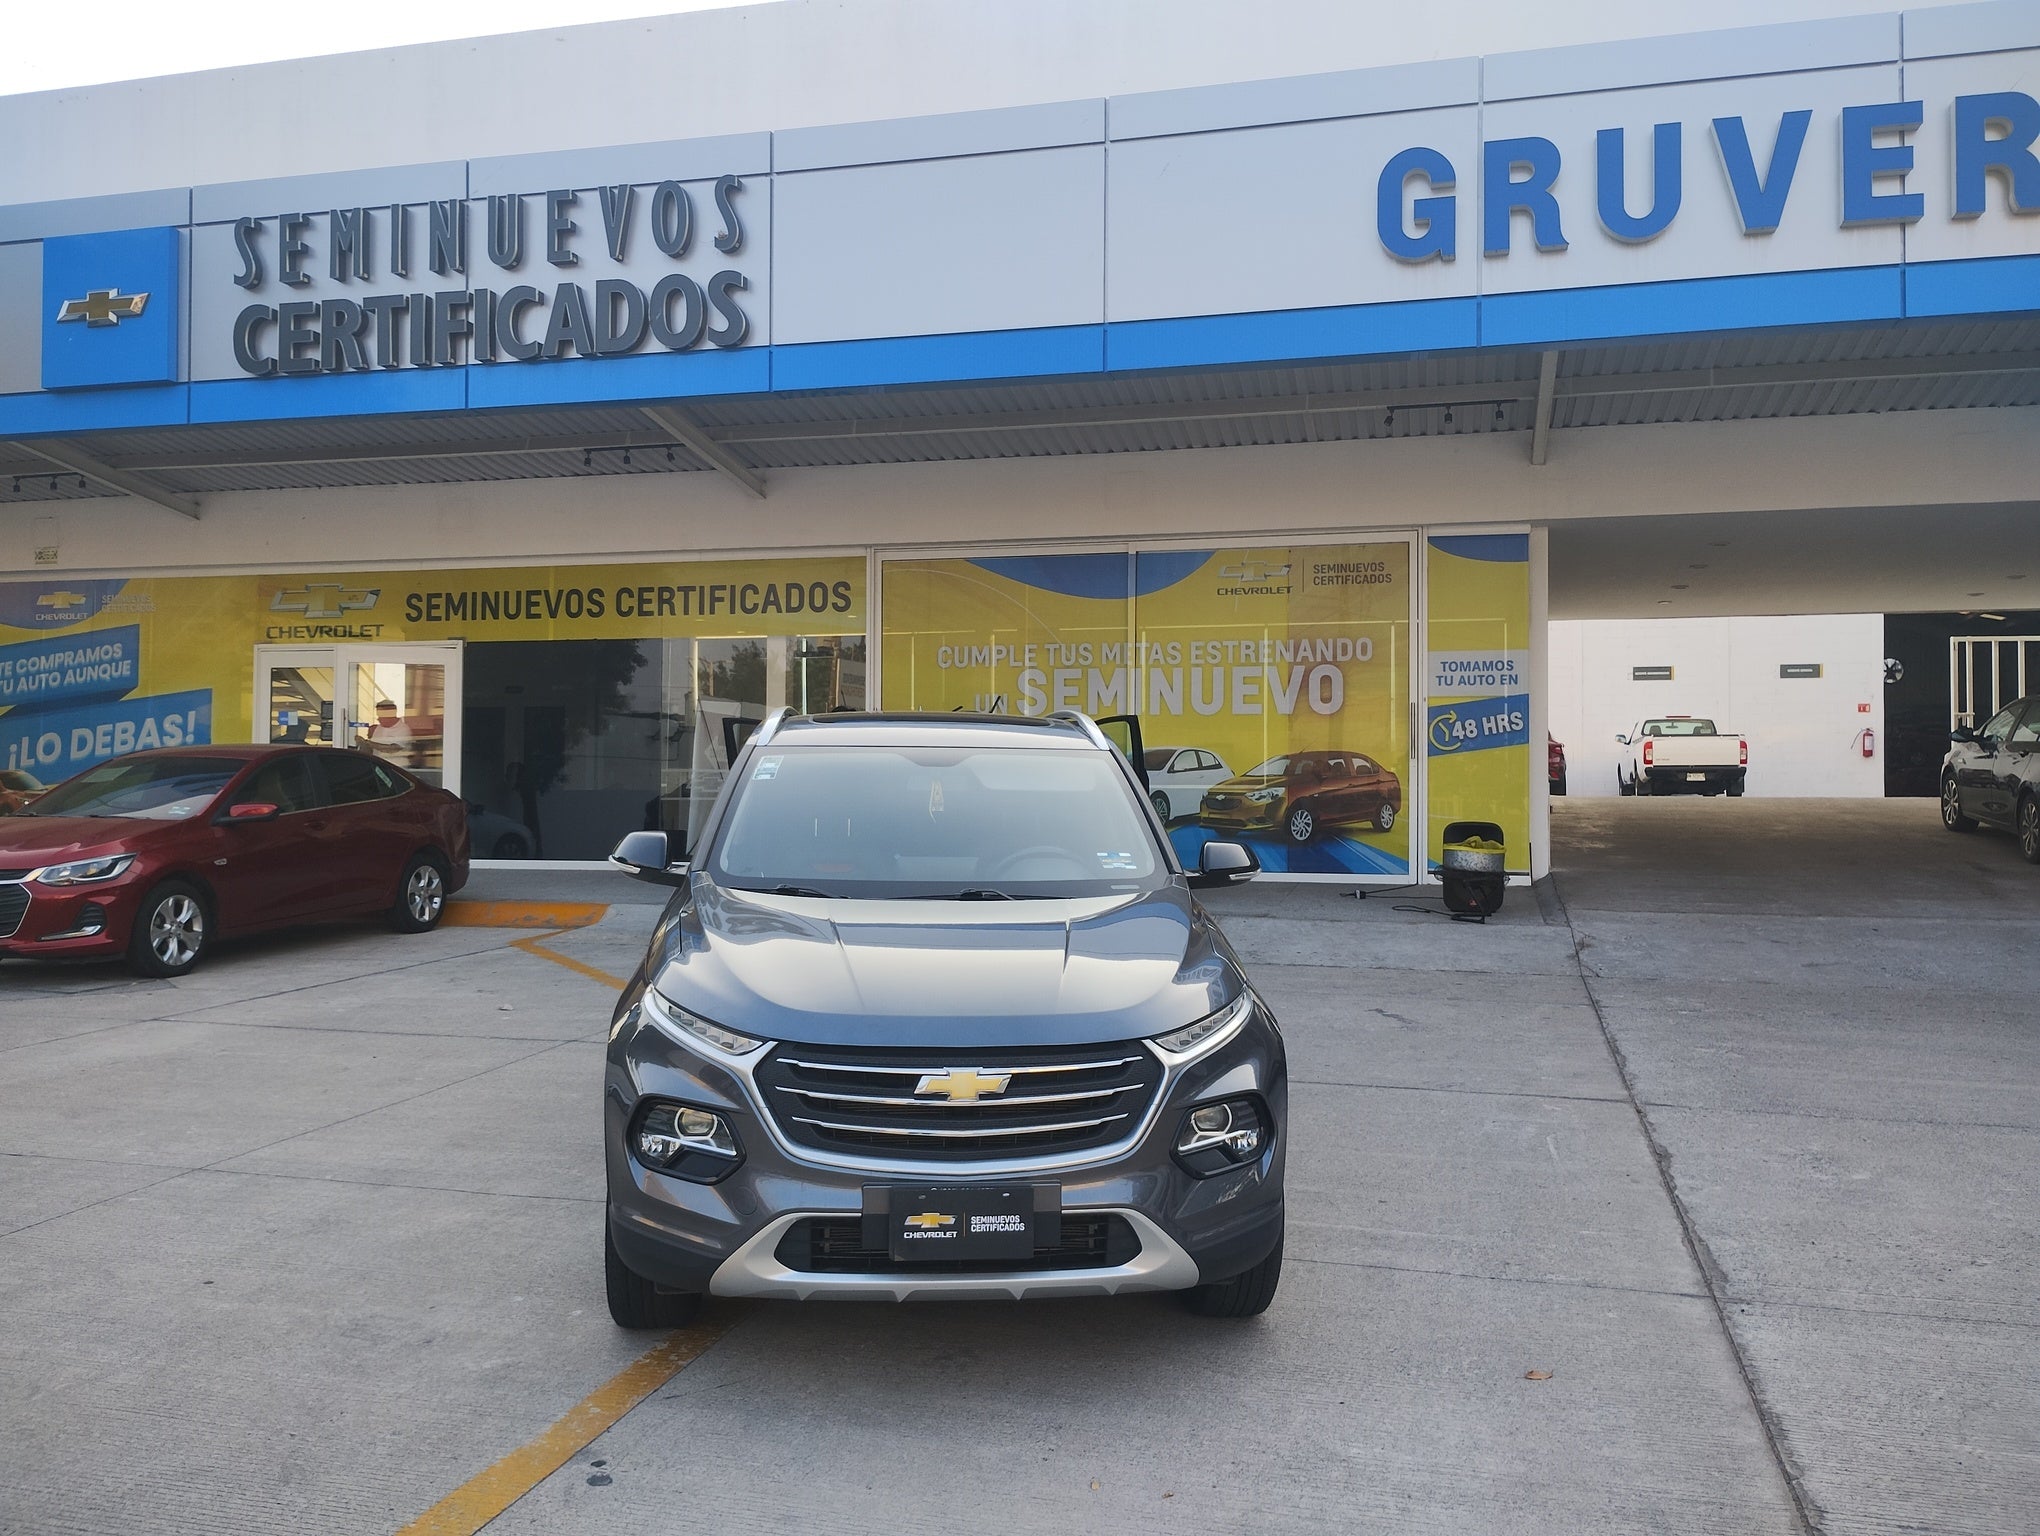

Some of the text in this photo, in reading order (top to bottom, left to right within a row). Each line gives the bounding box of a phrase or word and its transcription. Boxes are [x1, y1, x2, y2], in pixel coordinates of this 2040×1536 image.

[233, 174, 744, 290] SEMINUEVOS
[233, 269, 749, 378] CERTIFICADOS
[1313, 562, 1385, 575] SEMINUEVOS
[1313, 573, 1392, 586] CERTIFICADOS
[1216, 585, 1293, 596] CHEVROLET
[405, 581, 852, 623] SEMINUEVOS CERTIFICADOS
[35, 612, 88, 622] CHEVROLET
[265, 624, 385, 640] CHEVROLET
[16, 643, 123, 674] COMPRAMOS
[937, 637, 1373, 669] CUMPLE TUS METAS ESTRENANDO
[1440, 660, 1514, 673] TOMAMOS
[17, 673, 61, 693] AUTO
[63, 660, 132, 684] AUNQUE
[1436, 674, 1519, 687] TU AUTO EN
[975, 663, 1344, 716] UN SEMINUEVO
[1452, 711, 1524, 740] 48 HRS
[9, 710, 197, 770] ¡LO DEBAS!
[971, 1215, 1020, 1224] SEMINUEVOS
[903, 1231, 958, 1239] CHEVROLET
[971, 1223, 1025, 1233] CERTIFICADOS
